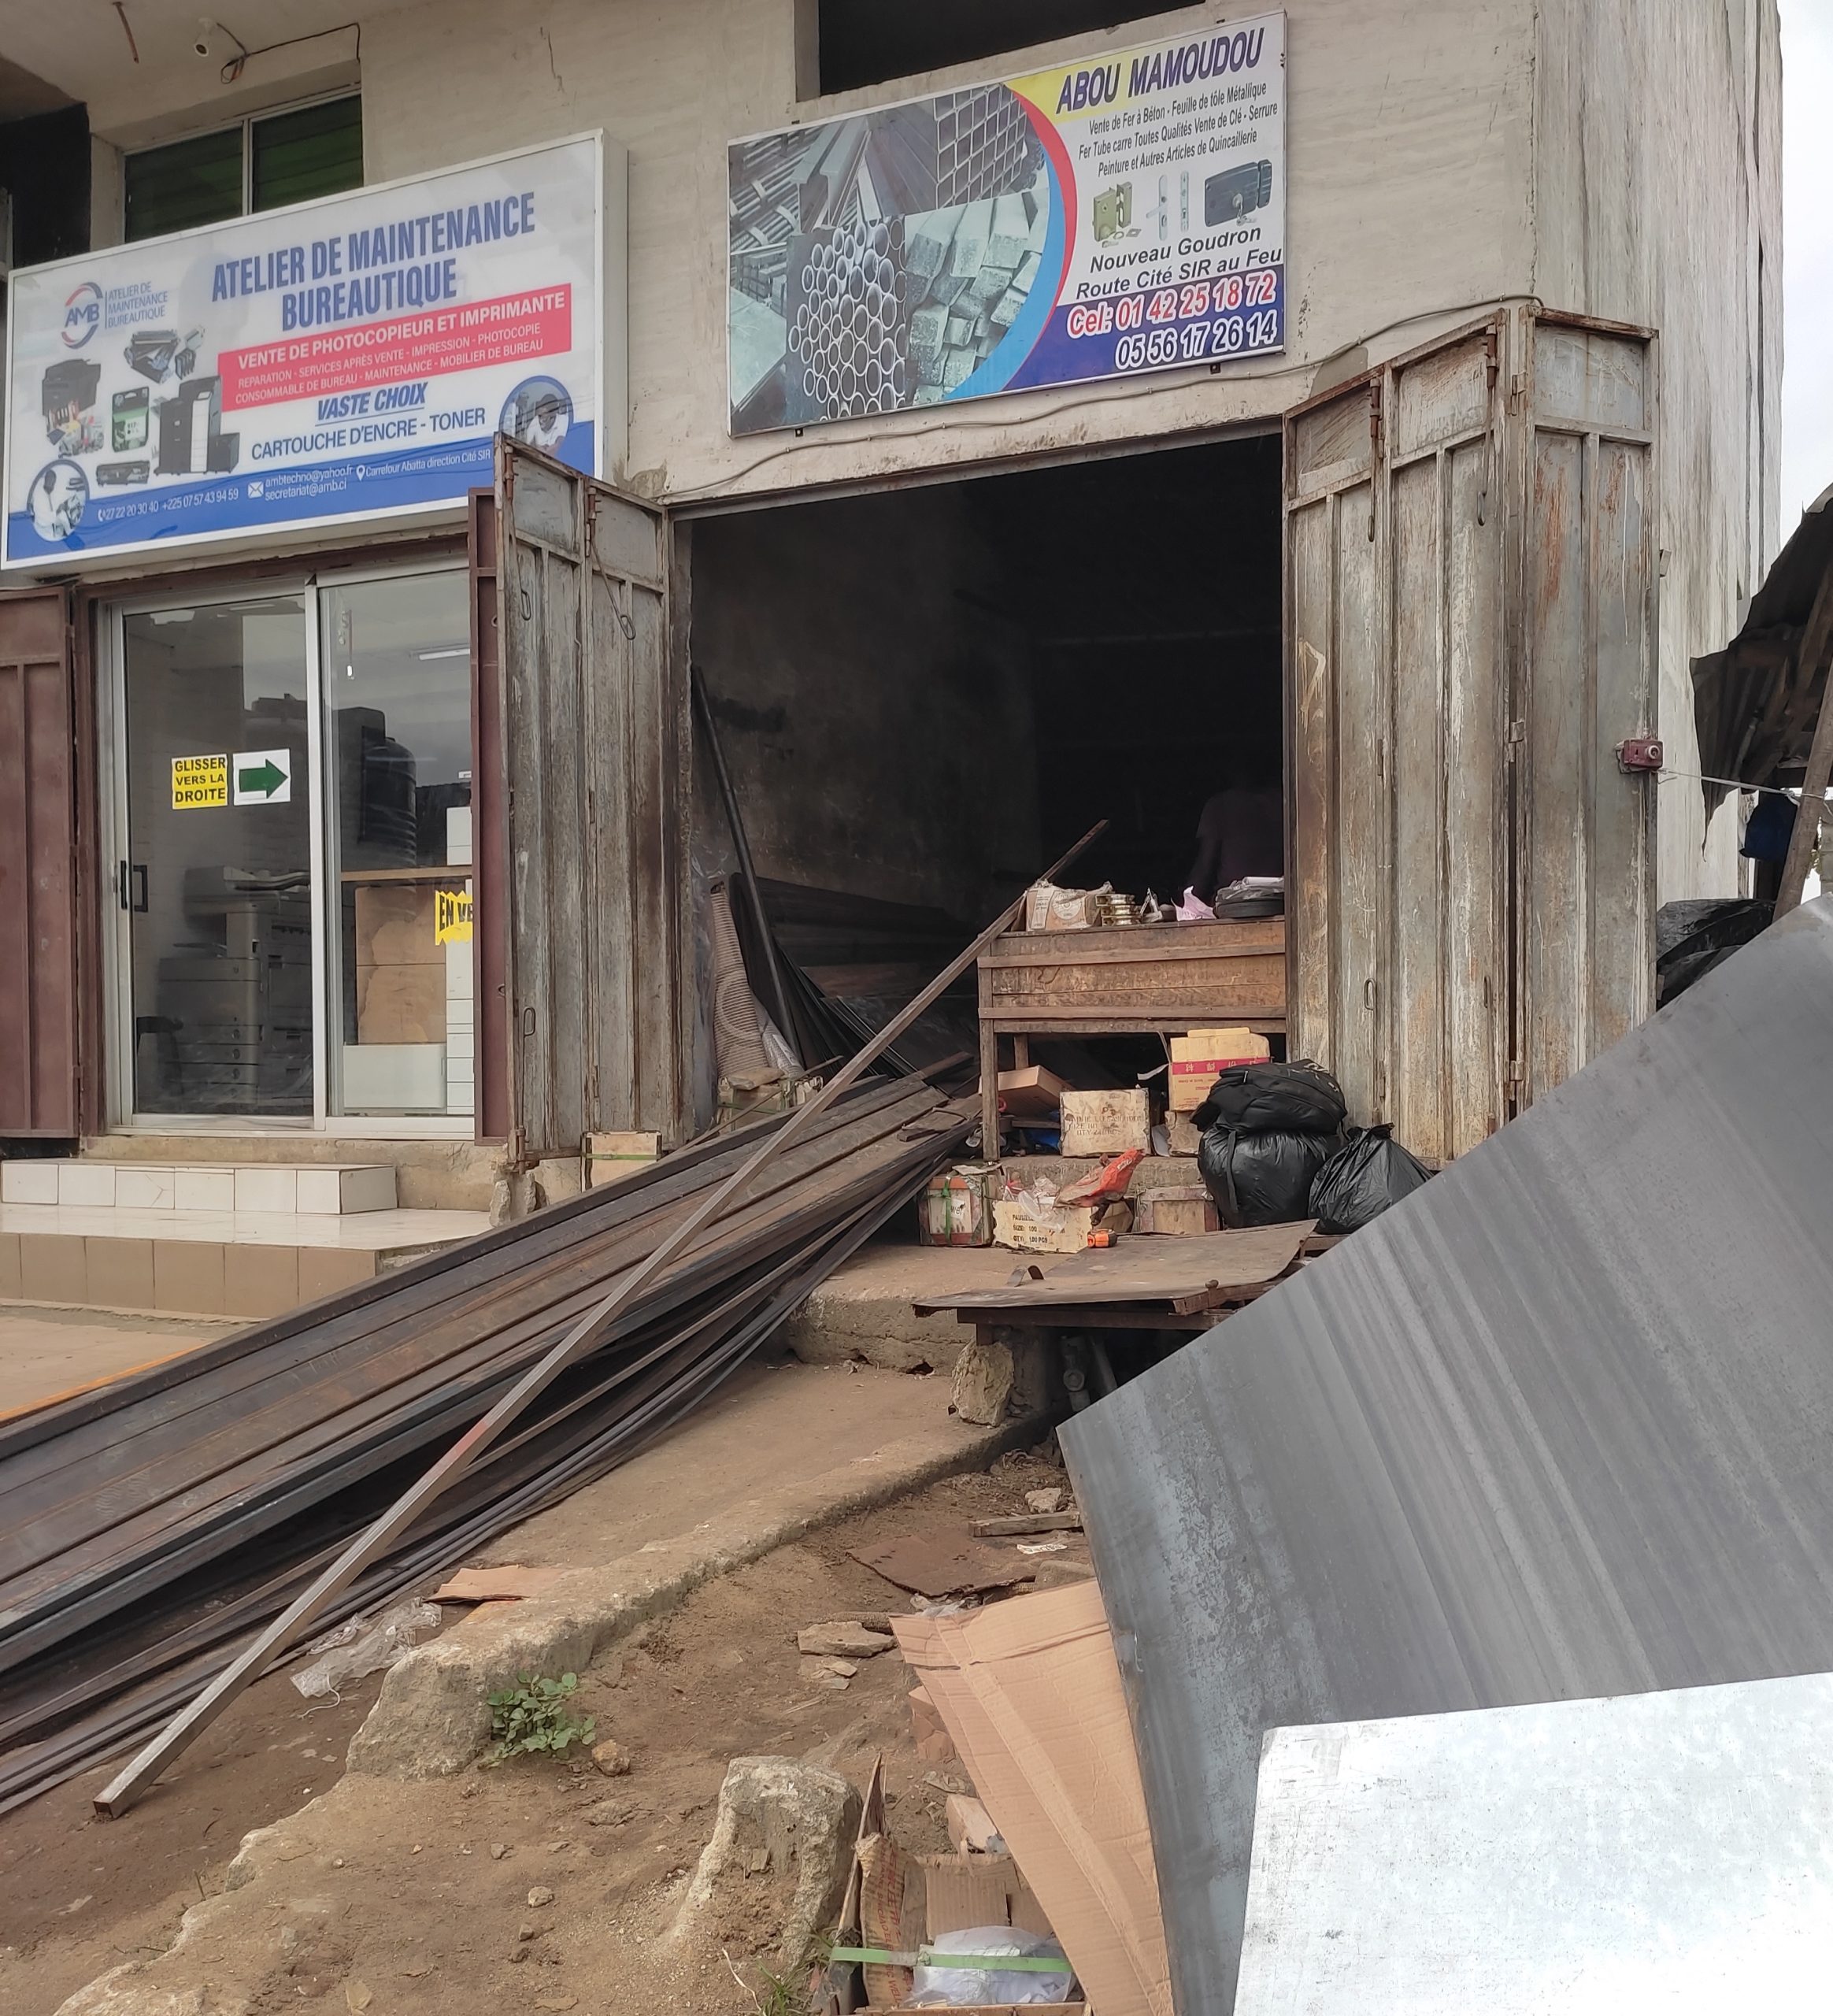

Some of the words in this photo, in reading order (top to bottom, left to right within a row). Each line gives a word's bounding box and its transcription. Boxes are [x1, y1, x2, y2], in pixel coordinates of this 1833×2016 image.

[1056, 63, 1121, 114] ABOU
[1128, 27, 1265, 98] MAMOUDOU
[1079, 144, 1091, 160] Fer
[1094, 140, 1111, 157] Tube
[1113, 137, 1131, 152] carre
[1135, 130, 1159, 147] Toutes
[1161, 118, 1192, 142] Qualités
[1194, 116, 1215, 134] Vente
[1217, 112, 1227, 128] de
[1229, 107, 1242, 125] Clé
[1249, 102, 1277, 120] Serrure
[1089, 118, 1109, 135] Vente
[1112, 114, 1120, 130] de
[1122, 112, 1135, 128] Fer
[1136, 109, 1141, 124] à
[1143, 106, 1165, 123] Béton
[1172, 96, 1197, 117] Feuille
[1198, 93, 1208, 109] de
[1227, 82, 1266, 103] Métallique
[1098, 160, 1129, 176] Peinture
[1131, 154, 1139, 170] et
[1139, 151, 1165, 169] Autres
[1166, 143, 1194, 162] Articles
[1197, 139, 1206, 155] de
[1209, 128, 1257, 153] Quincaillerie
[212, 246, 305, 302] ATELIER
[312, 237, 342, 280] DE
[349, 191, 535, 272] MAINTENANCE
[1090, 246, 1171, 273] Nouveau
[1178, 227, 1261, 255] Goudron
[109, 284, 139, 301] ATELIER
[140, 281, 152, 294] DE
[283, 258, 457, 332] BUREAUTIQUE
[1076, 279, 1130, 299] Route
[1137, 266, 1172, 288] Cité
[1179, 258, 1211, 280] SIR
[1217, 257, 1239, 273] au
[1246, 248, 1282, 267] Feu
[65, 303, 99, 328] AMB
[108, 305, 165, 328] BUREAUTIQUE
[109, 291, 168, 314] MAINTENANCE
[1068, 302, 1113, 338] Cel:
[1117, 295, 1144, 329] 01
[1148, 287, 1176, 323] 42
[1181, 281, 1210, 317] 25
[1214, 276, 1241, 310] 18
[1246, 271, 1276, 305] 72
[239, 347, 286, 369] VENTE
[290, 343, 309, 359] DE
[313, 318, 433, 355] PHOTOCOPIEUR
[437, 313, 457, 332] ET
[460, 292, 565, 328] IMPRIMANTE
[1116, 333, 1144, 369] 05
[1148, 328, 1176, 363] 56
[1182, 322, 1210, 358] 17
[1213, 317, 1242, 352] 26
[1247, 311, 1276, 346] 14
[235, 383, 304, 404] CONSOMMABLE
[306, 380, 319, 392] DE
[320, 372, 357, 389] BUREAU
[365, 360, 431, 381] MAINTENANCE
[440, 350, 485, 368] MOBILIER
[488, 348, 501, 359] DE
[504, 339, 543, 356] BUREAU
[239, 370, 291, 389] REPARATION
[299, 361, 341, 378] SERVICES
[343, 352, 372, 370] APRÈS
[376, 348, 404, 363] VENTE
[412, 336, 470, 358] IMPRESSION
[478, 323, 540, 343] PHOTOCOPIE
[317, 392, 370, 421] VASTE
[374, 382, 428, 412] CHOIX
[251, 429, 346, 460] CARTOUCHE
[350, 418, 417, 445] D'ENCRE
[429, 407, 485, 432] TONER
[365, 464, 399, 476] Carrefour
[401, 460, 425, 472] Abatta
[427, 454, 460, 468] direction
[461, 451, 477, 463] Cité
[478, 449, 491, 461] SIR
[137, 502, 147, 514] 30
[149, 500, 158, 513] 40
[265, 477, 346, 501] secretariat@amb.ci
[175, 757, 225, 772] GLISSER
[176, 774, 206, 785] VERS
[210, 773, 224, 783] LA
[175, 788, 225, 802] DROITE
[439, 894, 454, 932] EN
